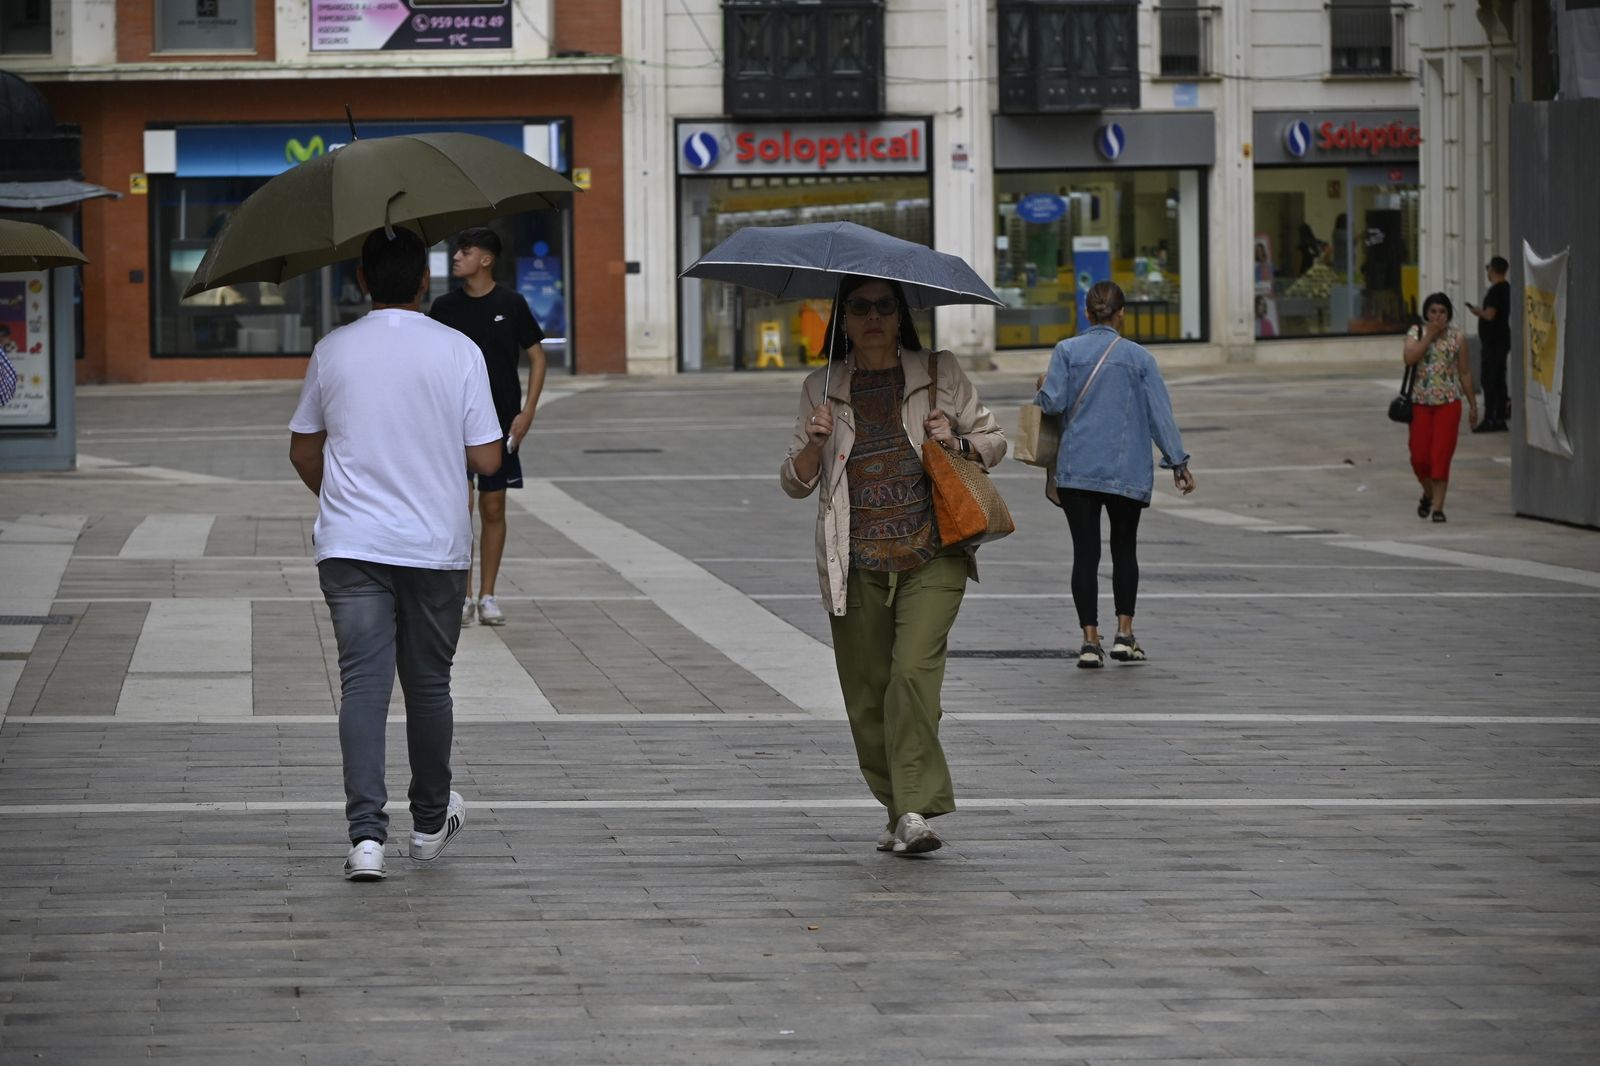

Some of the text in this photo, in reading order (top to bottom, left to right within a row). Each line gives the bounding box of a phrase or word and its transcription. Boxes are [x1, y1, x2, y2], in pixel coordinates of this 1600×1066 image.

[430, 16, 505, 29] 959 04 42 49
[735, 128, 920, 168] Soloptical
